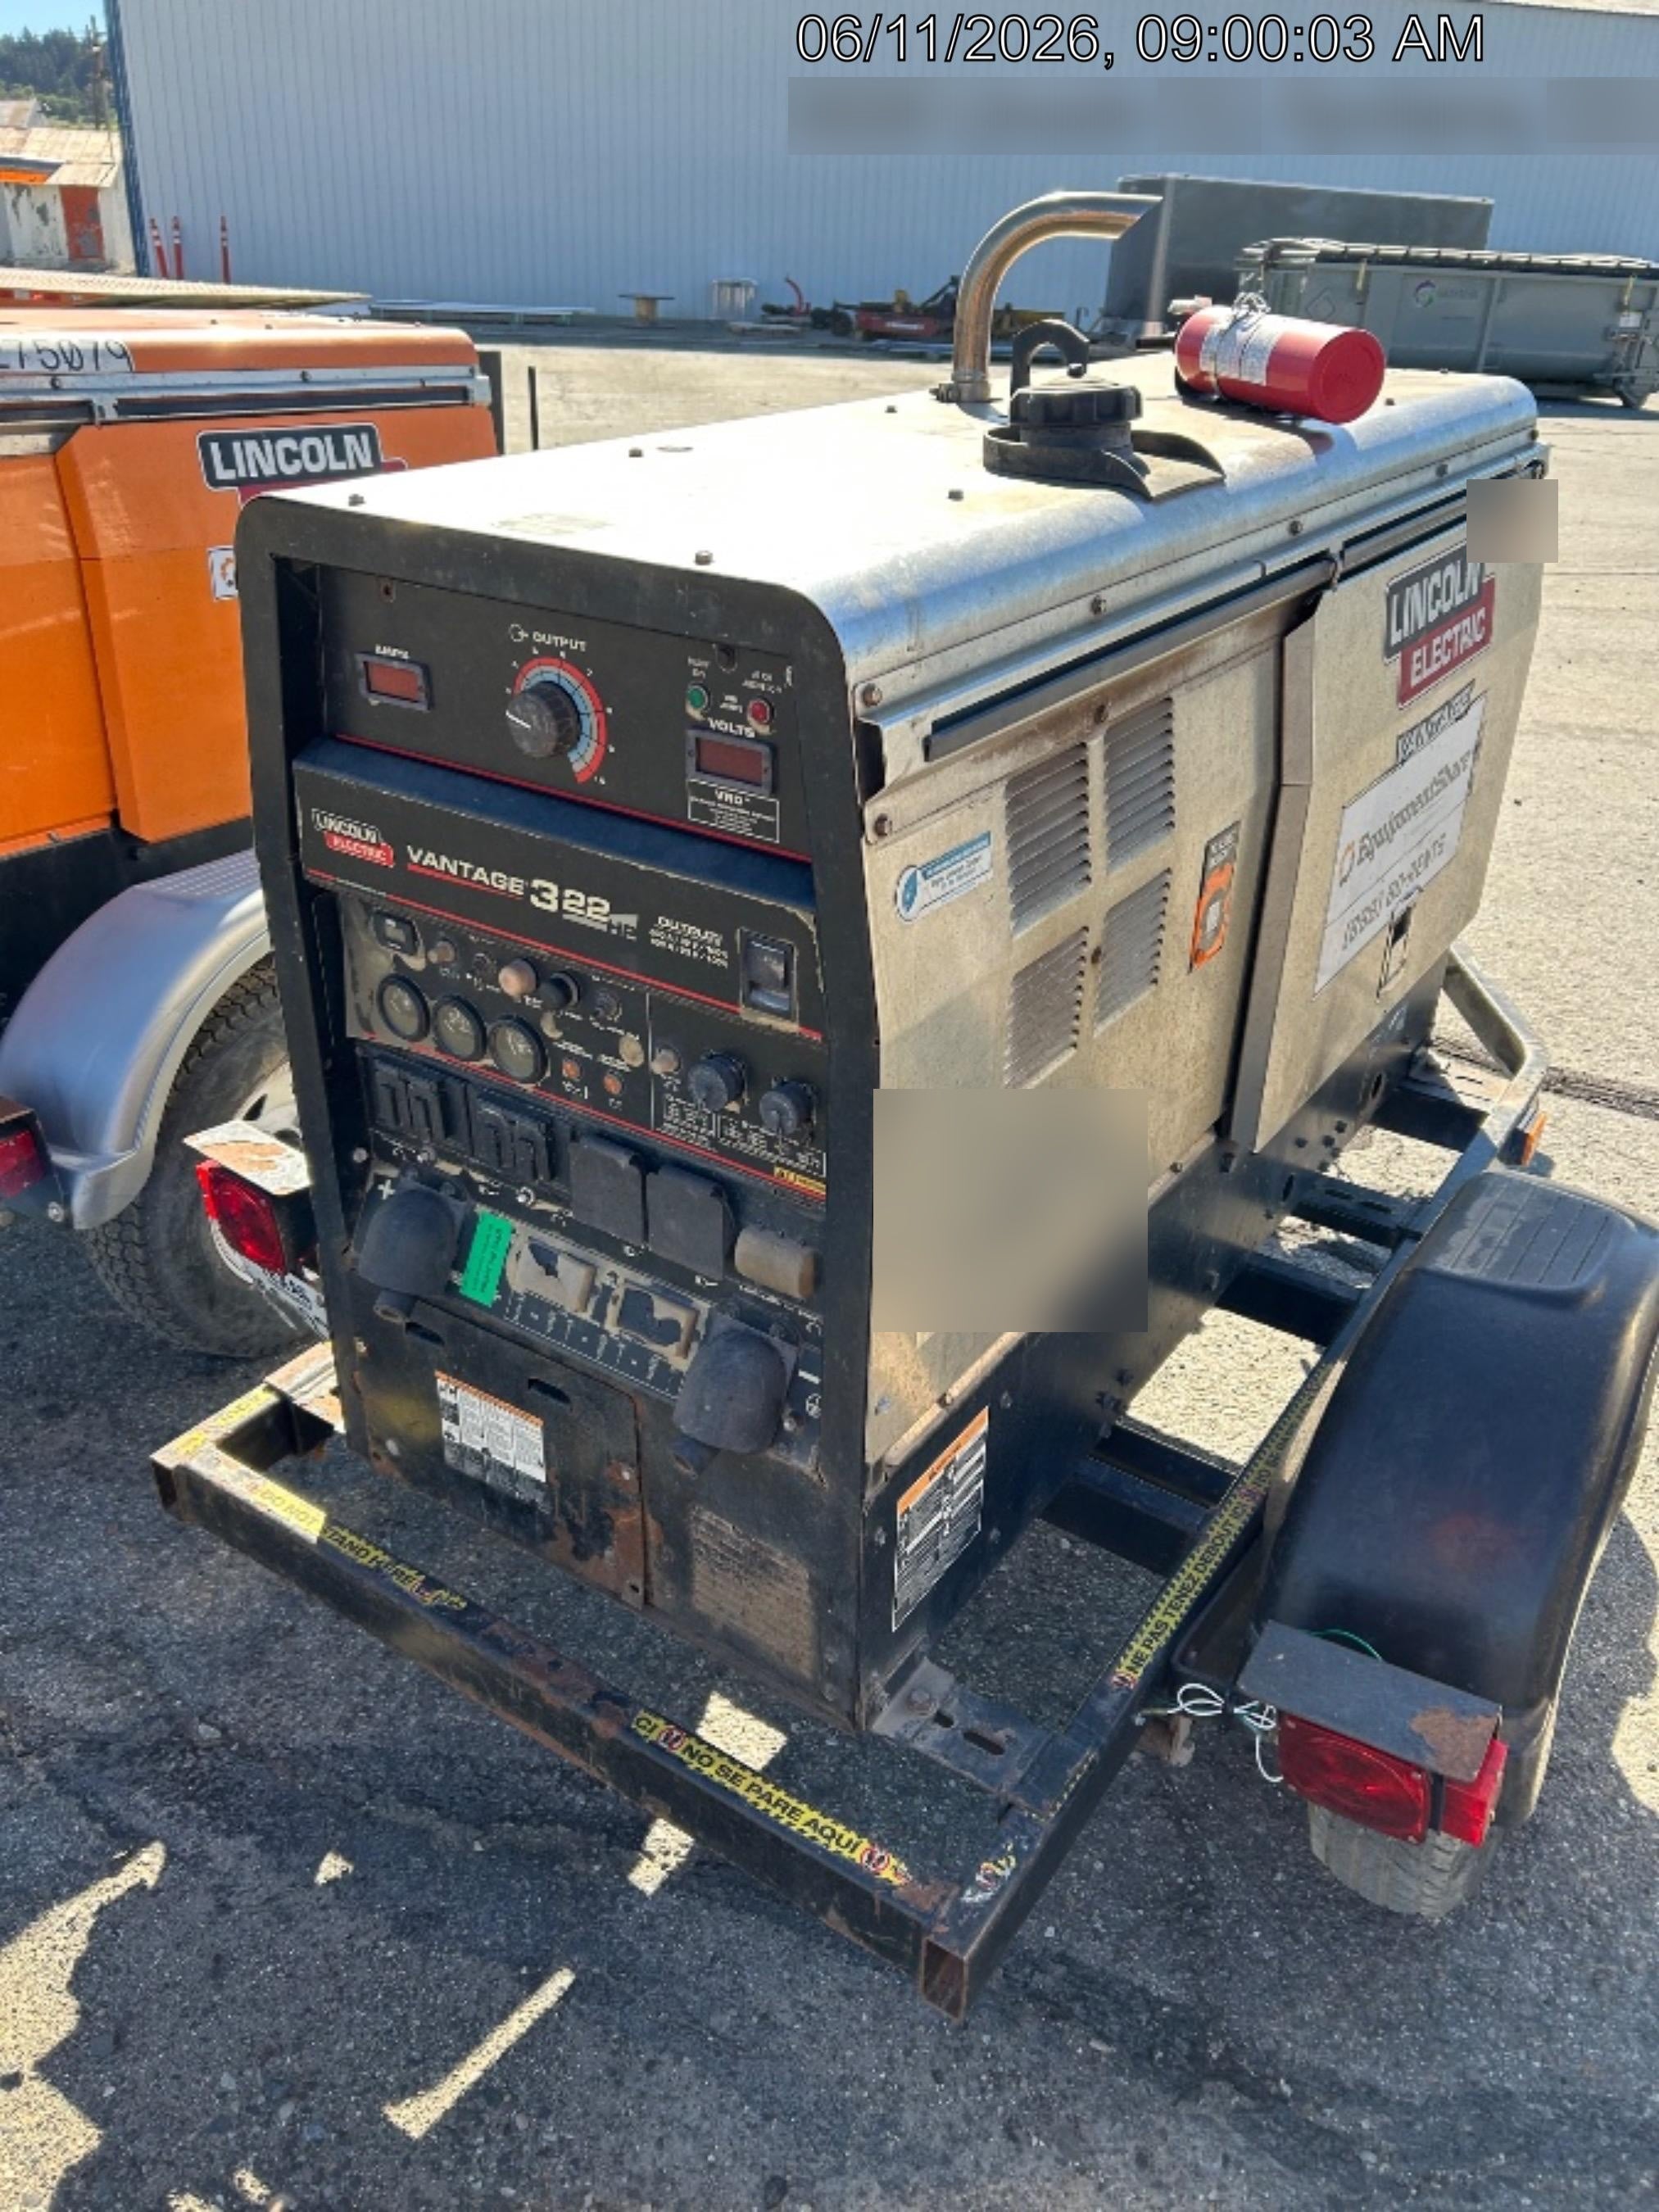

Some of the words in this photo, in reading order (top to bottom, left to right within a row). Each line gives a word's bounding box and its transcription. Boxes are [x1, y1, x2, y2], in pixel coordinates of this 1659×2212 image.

[210, 432, 374, 480] LINCOLN
[533, 631, 587, 652] OUTPUT
[1390, 560, 1481, 646] LINCOLN
[1410, 606, 1486, 688] ELECTRIC
[708, 717, 755, 738] VOLTS
[316, 812, 377, 844] LINCOLN
[406, 845, 525, 896] VANTAGE
[529, 878, 611, 923] 322
[1141, 1619, 1170, 1652] PAS
[1163, 1571, 1200, 1619] TENEZ
[682, 1743, 715, 1768] NO
[714, 1763, 747, 1788] SE
[745, 1780, 805, 1823] PARE
